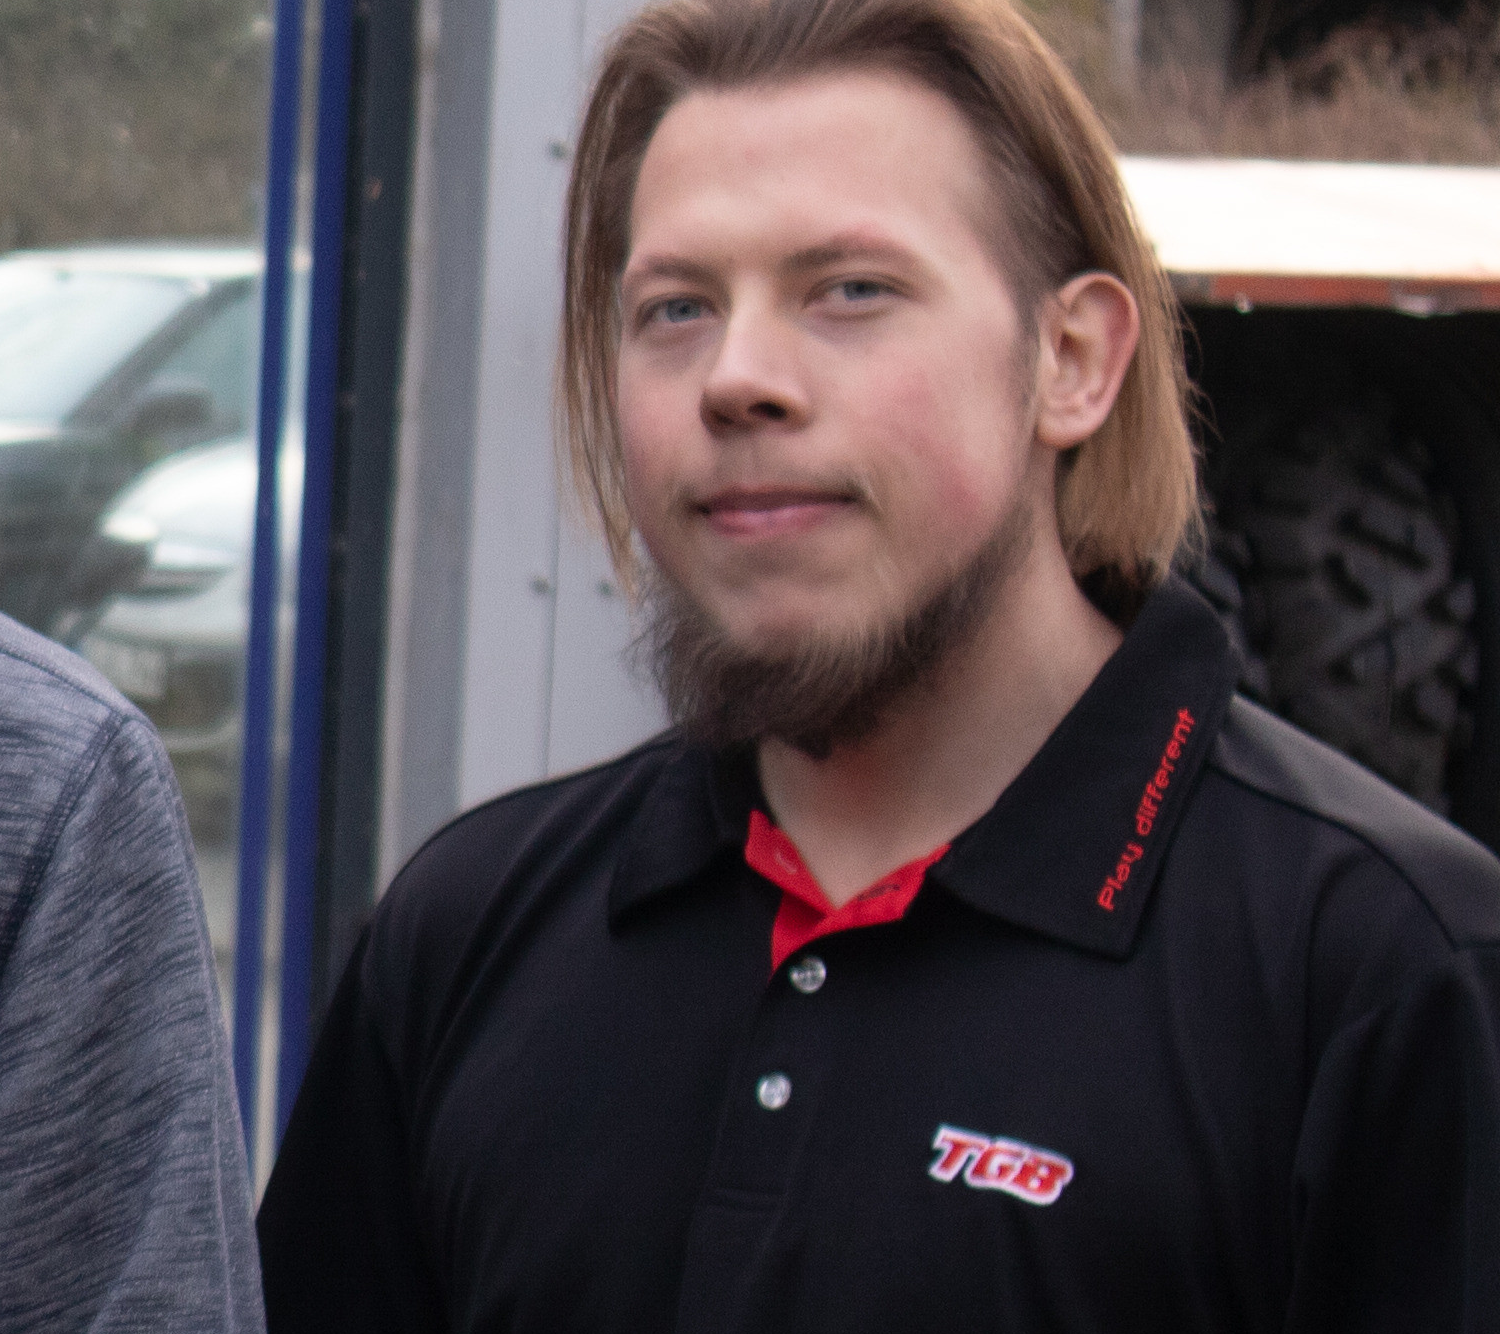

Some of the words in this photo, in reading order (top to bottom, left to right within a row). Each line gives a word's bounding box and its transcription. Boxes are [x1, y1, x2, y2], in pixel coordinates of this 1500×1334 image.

[1098, 840, 1145, 913] Play
[1134, 707, 1197, 838] different
[928, 1123, 1074, 1206] TGB
